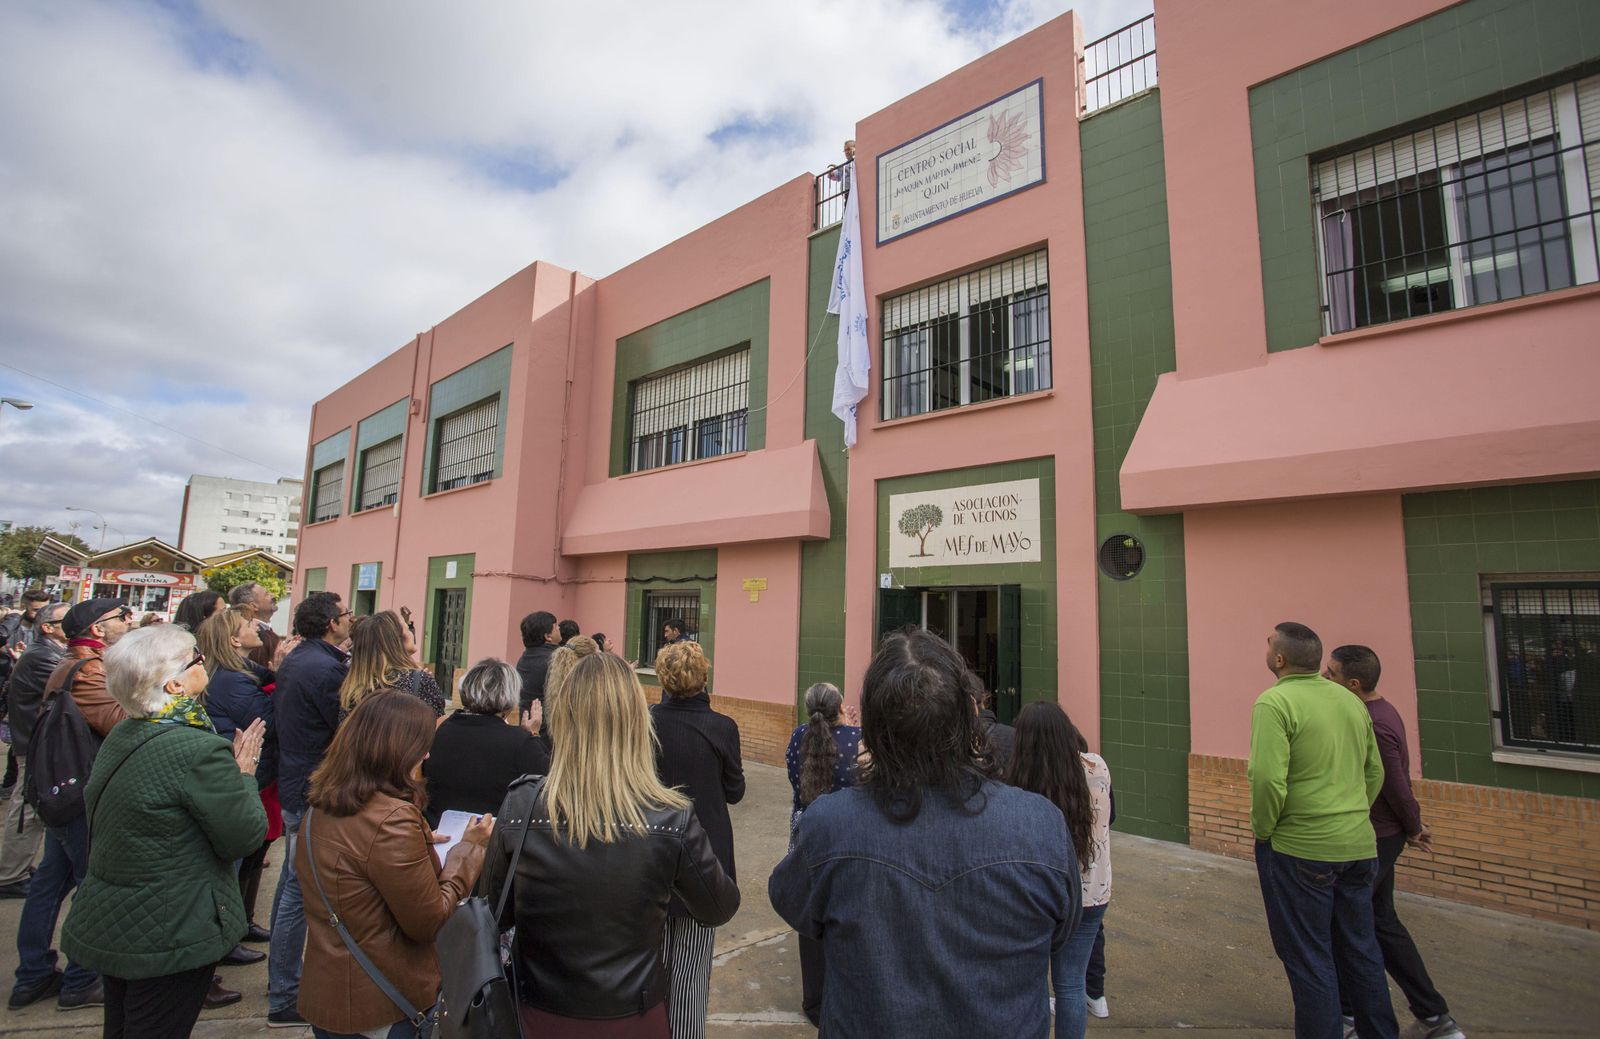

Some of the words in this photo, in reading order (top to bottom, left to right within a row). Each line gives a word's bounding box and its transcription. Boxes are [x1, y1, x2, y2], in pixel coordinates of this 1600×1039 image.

[897, 155, 936, 181] CENTRO
[939, 137, 977, 163] SOCIAL
[894, 179, 923, 198] JOAQUIN
[903, 200, 949, 224] AYUNTAMIENTO
[949, 195, 958, 207] DE
[959, 185, 984, 202] HUELVA
[953, 513, 965, 525] DE
[972, 508, 1017, 523] VECINOS
[942, 534, 975, 558] MES
[975, 540, 989, 553] DE
[990, 531, 1032, 555] MAYO
